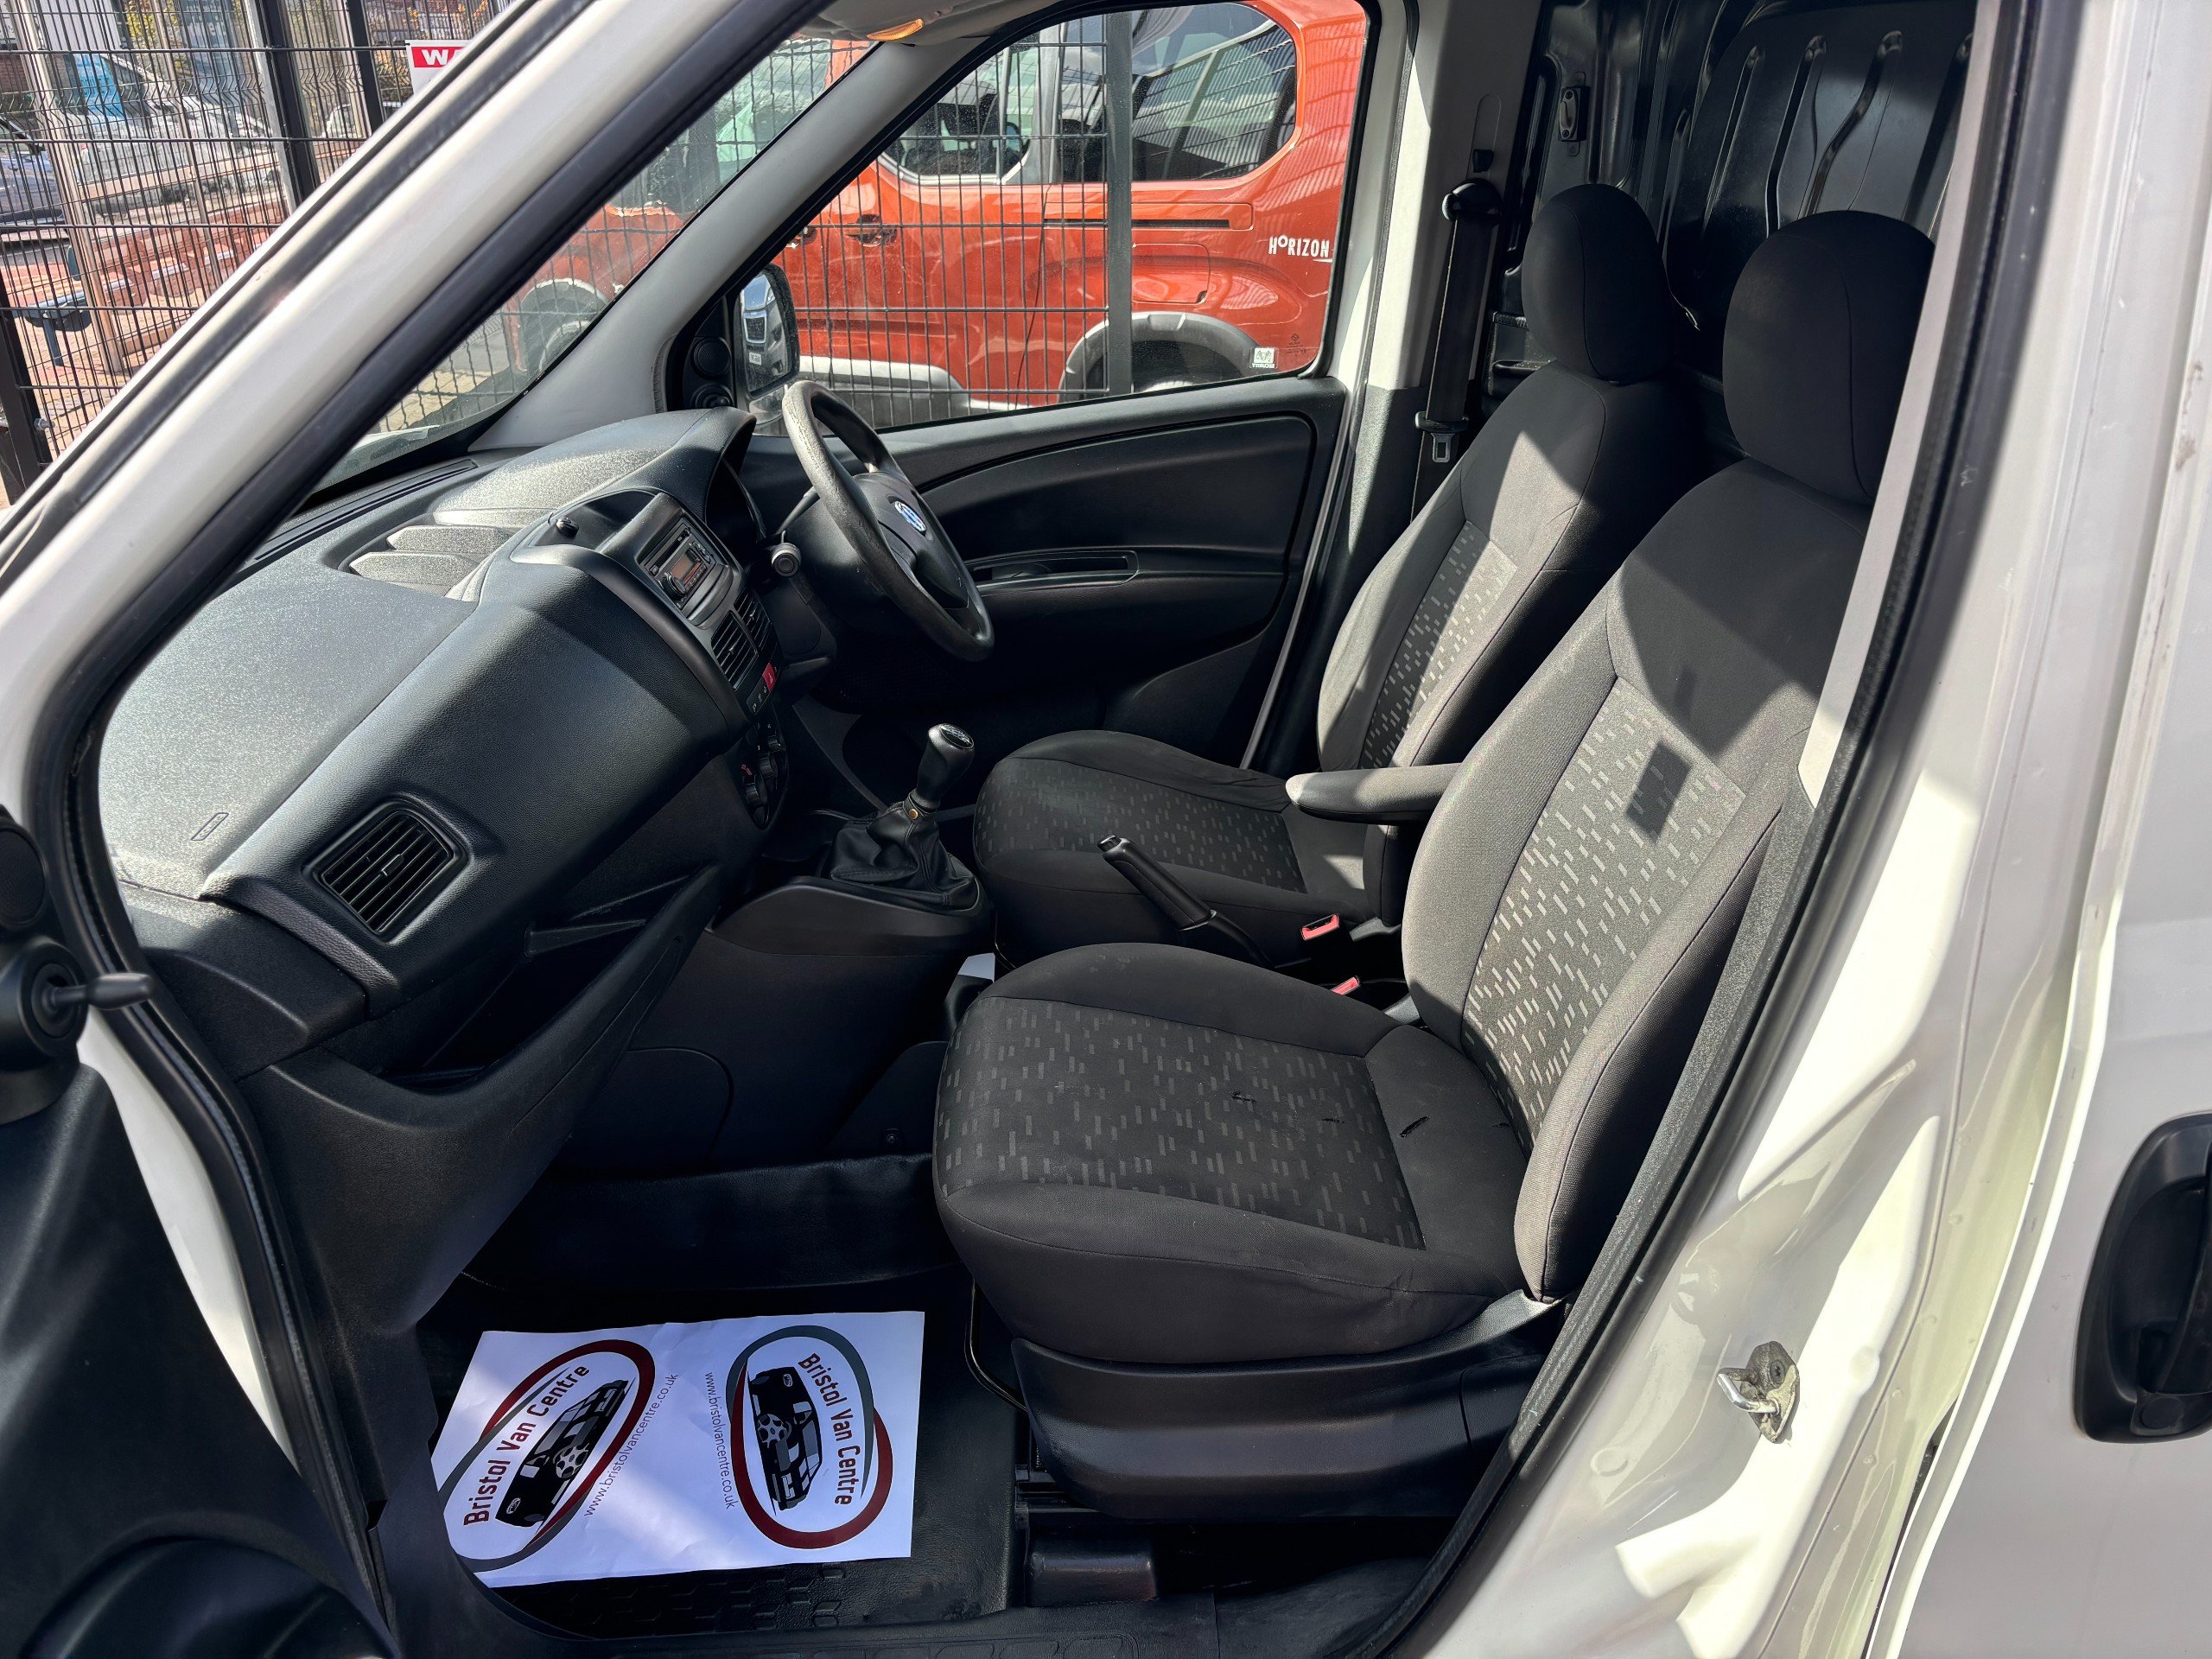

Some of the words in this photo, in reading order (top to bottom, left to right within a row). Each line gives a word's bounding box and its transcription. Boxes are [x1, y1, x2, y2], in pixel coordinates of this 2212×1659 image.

[1268, 233, 1330, 258] HORIZON
[798, 1352, 848, 1407] Bristol
[463, 1459, 512, 1526] Bristol
[496, 1421, 537, 1452] Van
[526, 1365, 590, 1418] Centre
[583, 1373, 679, 1517] www.bristolvancentre.co.uk
[704, 1371, 737, 1510] www.bristolvancentre.co.uk
[830, 1408, 855, 1442] Van
[834, 1445, 861, 1505] Centre
